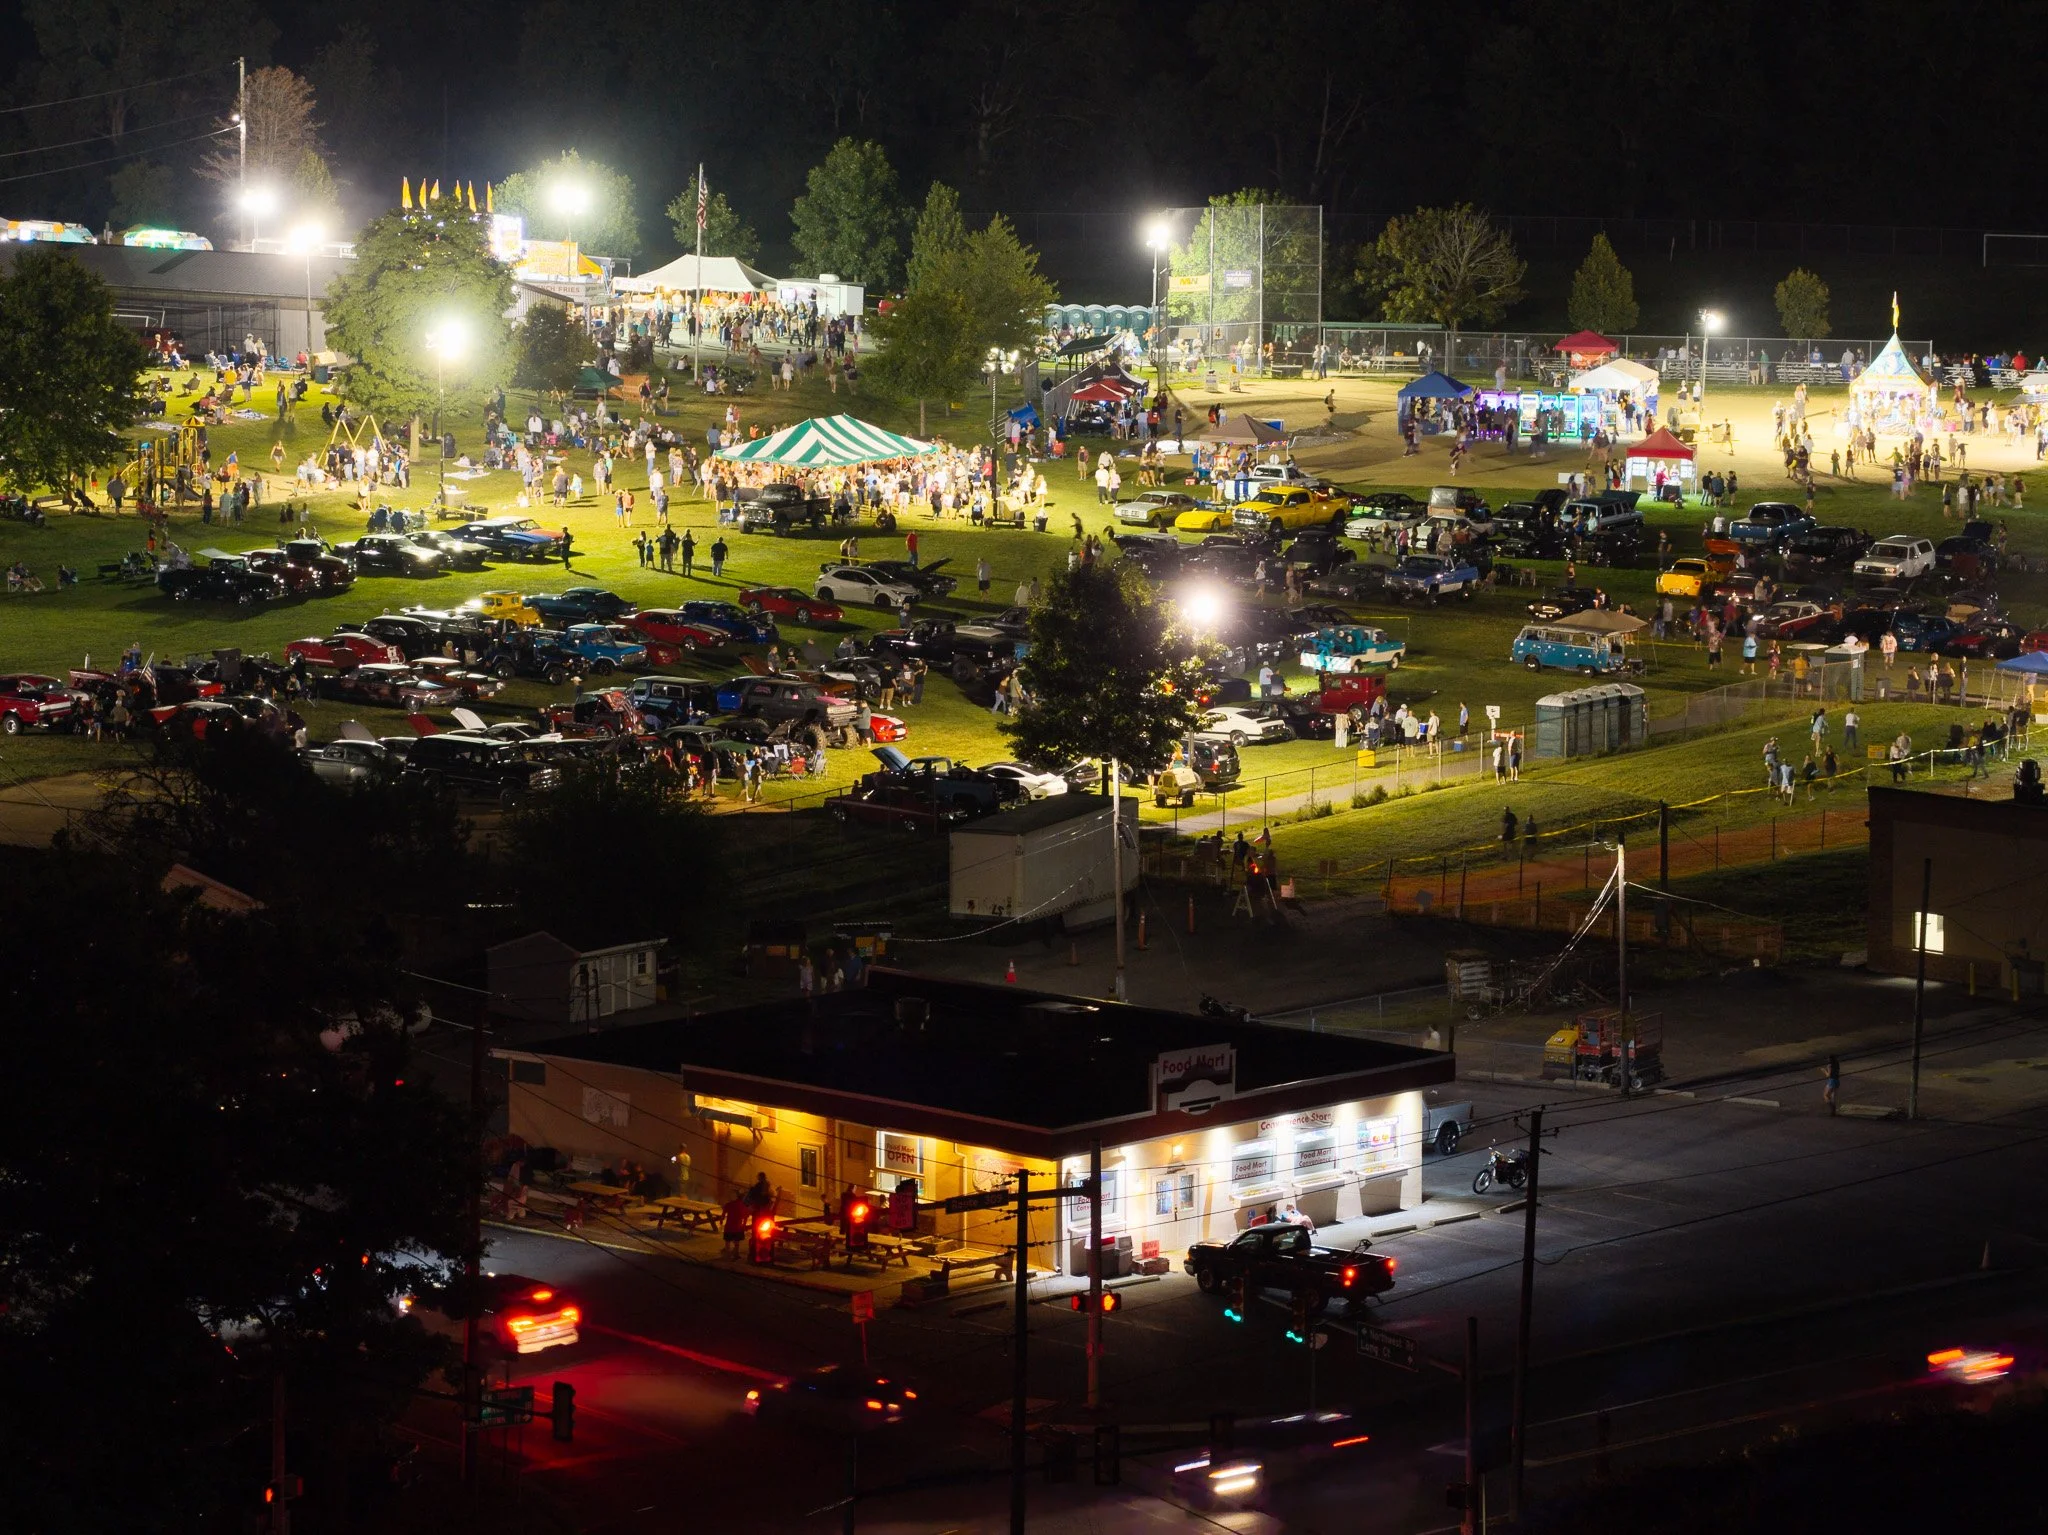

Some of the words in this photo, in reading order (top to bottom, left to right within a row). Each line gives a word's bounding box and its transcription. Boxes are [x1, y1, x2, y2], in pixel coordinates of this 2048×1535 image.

[1163, 1056, 1192, 1074] Food
[1197, 1053, 1225, 1067] Mart
[1260, 1115, 1309, 1131] Convience
[887, 1143, 901, 1151] Food
[901, 1145, 915, 1153] Mart
[1300, 1150, 1316, 1159] Food
[1317, 1148, 1332, 1157] Mart
[887, 1151, 914, 1164] OPEN
[1298, 1157, 1331, 1167] Convenience
[1235, 1162, 1251, 1172] Food
[1252, 1160, 1267, 1170] Mart
